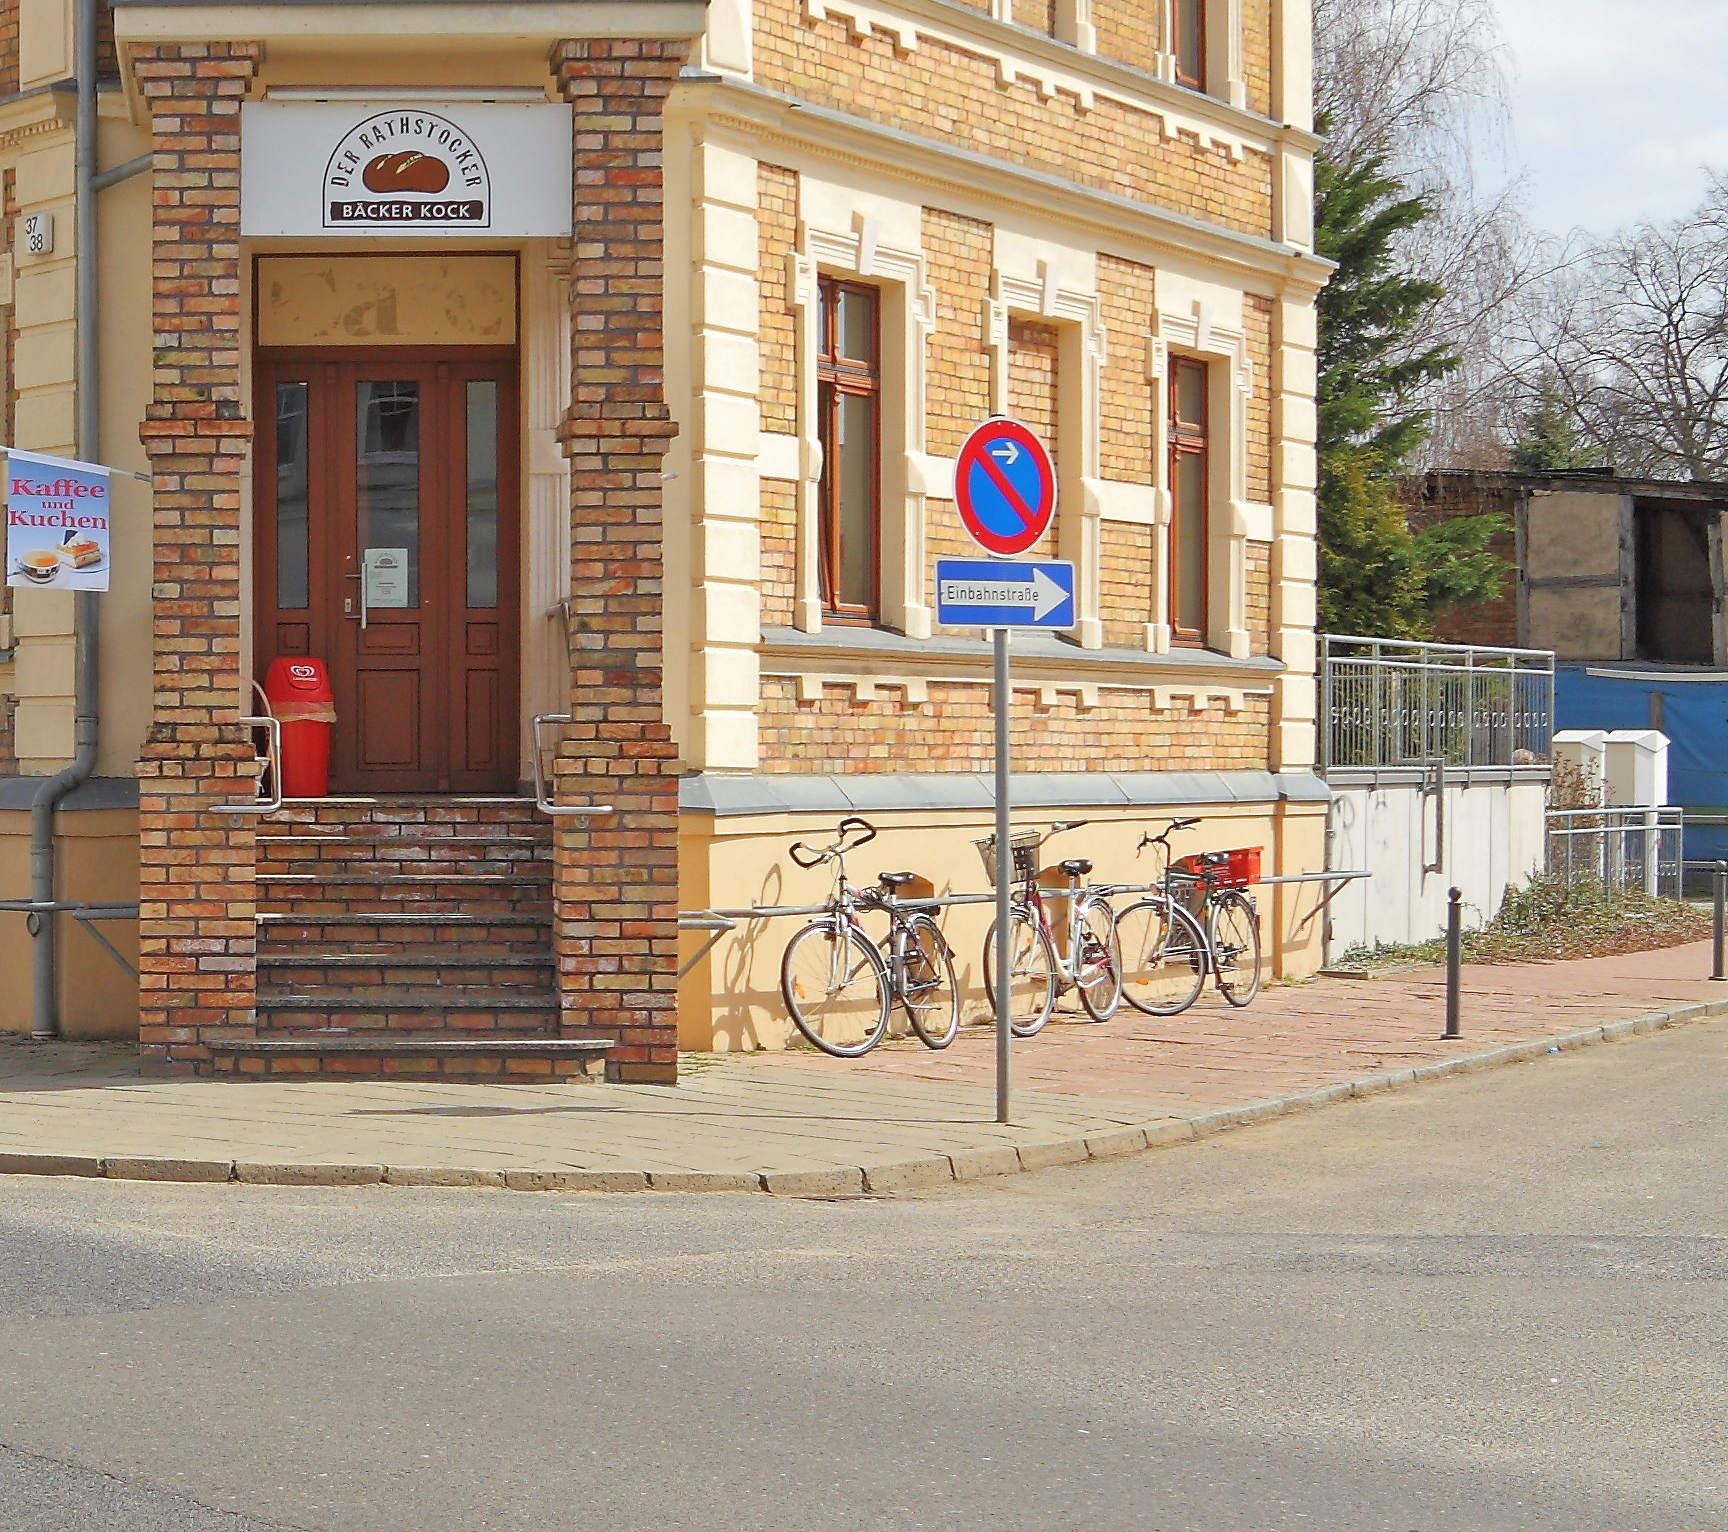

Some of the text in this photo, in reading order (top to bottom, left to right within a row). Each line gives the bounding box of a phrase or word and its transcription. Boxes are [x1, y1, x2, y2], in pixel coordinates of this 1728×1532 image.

[330, 116, 483, 188] DER RATHSTOCKER
[342, 202, 471, 218] BÄCKER KOCK
[25, 216, 38, 235] 37
[29, 233, 43, 251] 38
[11, 478, 106, 498] Kaffee
[41, 499, 74, 510] und
[9, 510, 108, 530] Kuchen
[947, 585, 1039, 602] Einbahnstraße
